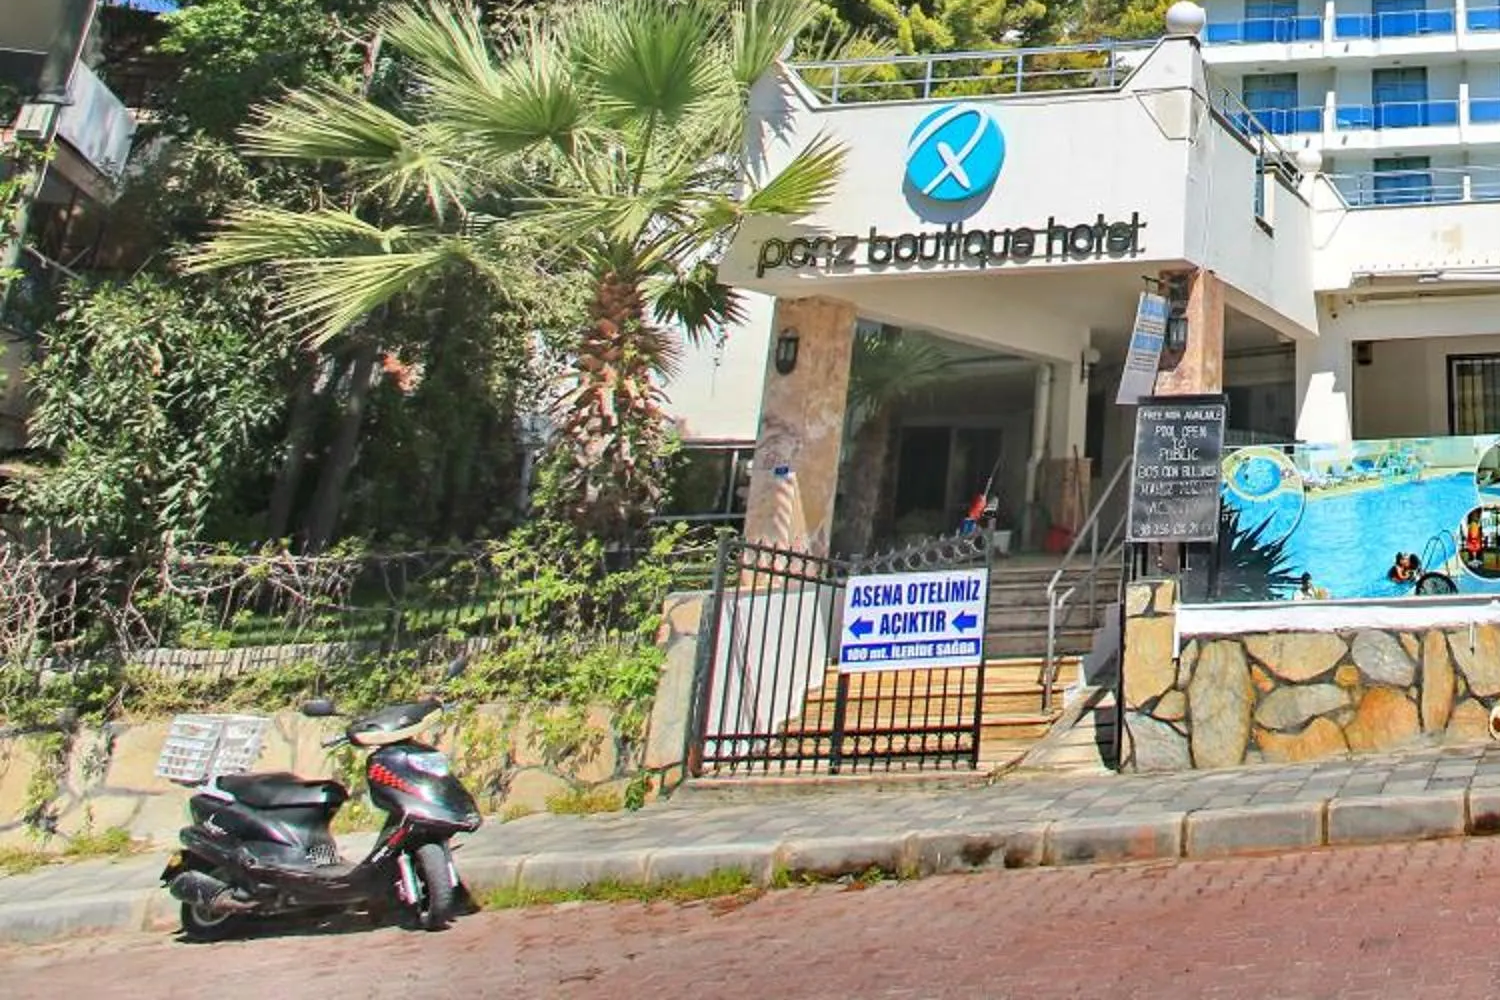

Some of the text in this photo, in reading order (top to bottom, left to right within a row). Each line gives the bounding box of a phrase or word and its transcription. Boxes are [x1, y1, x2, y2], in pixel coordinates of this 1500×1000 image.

[868, 222, 1035, 269] boutique
[1046, 211, 1140, 261] hotel
[851, 576, 981, 608] ASENA OTELİMİZ
[879, 610, 947, 639] AÇIKTIR
